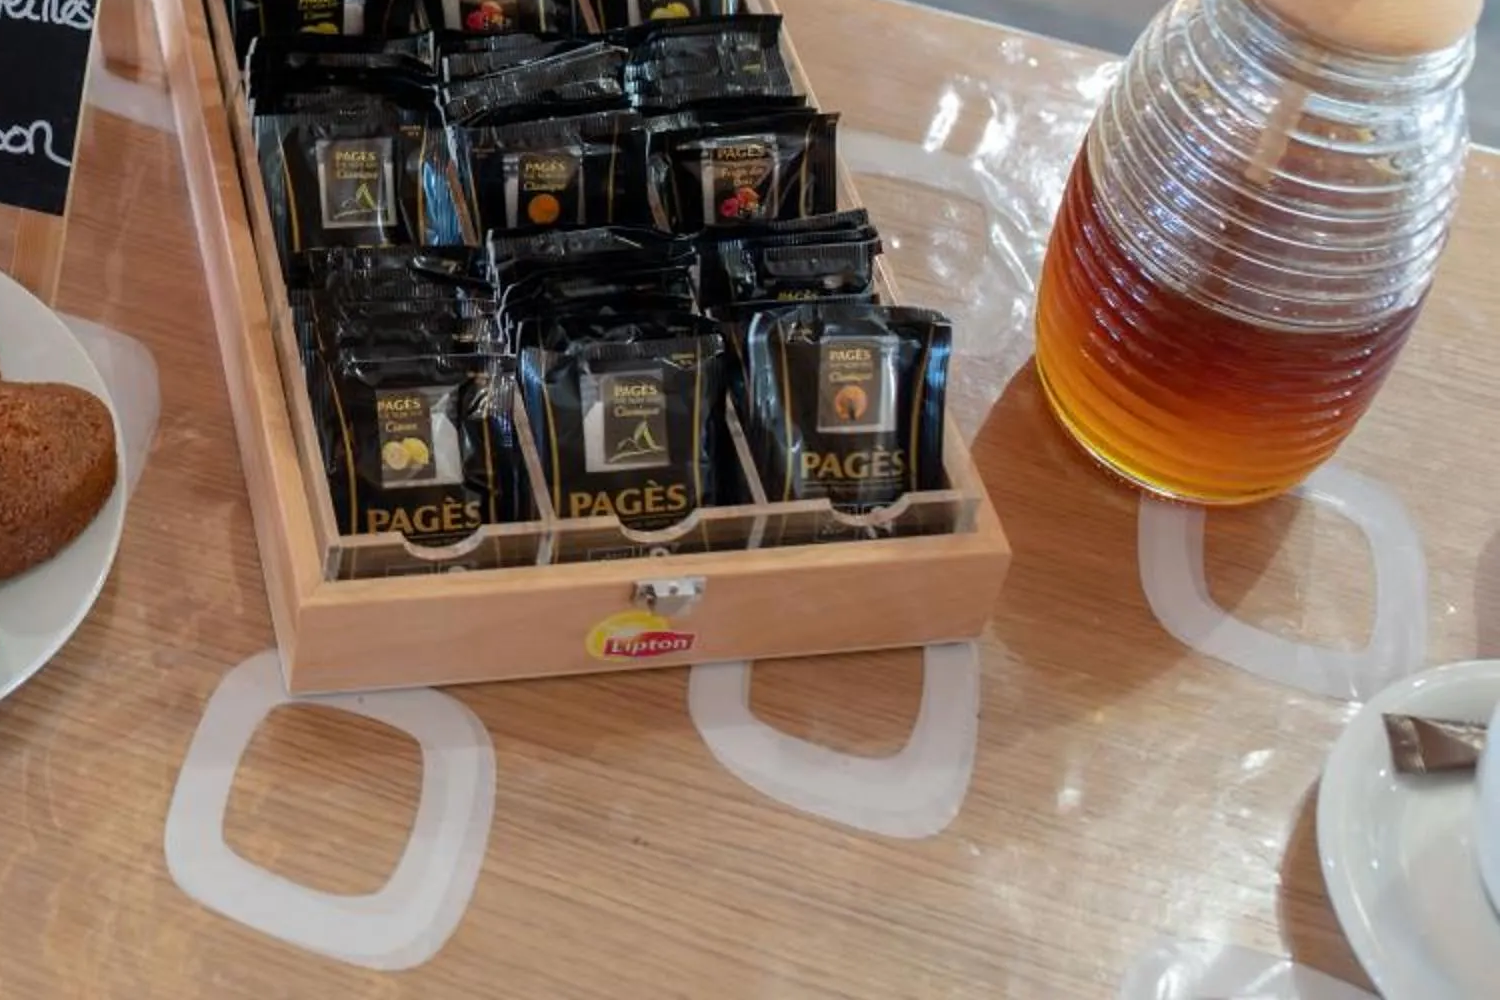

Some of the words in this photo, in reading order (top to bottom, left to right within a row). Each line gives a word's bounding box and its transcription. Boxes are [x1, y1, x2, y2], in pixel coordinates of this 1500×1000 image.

[801, 446, 905, 480] PAGÈS
[367, 496, 482, 535] PAGÈS
[569, 479, 688, 518] PAGÈS
[611, 637, 689, 656] Lipton
